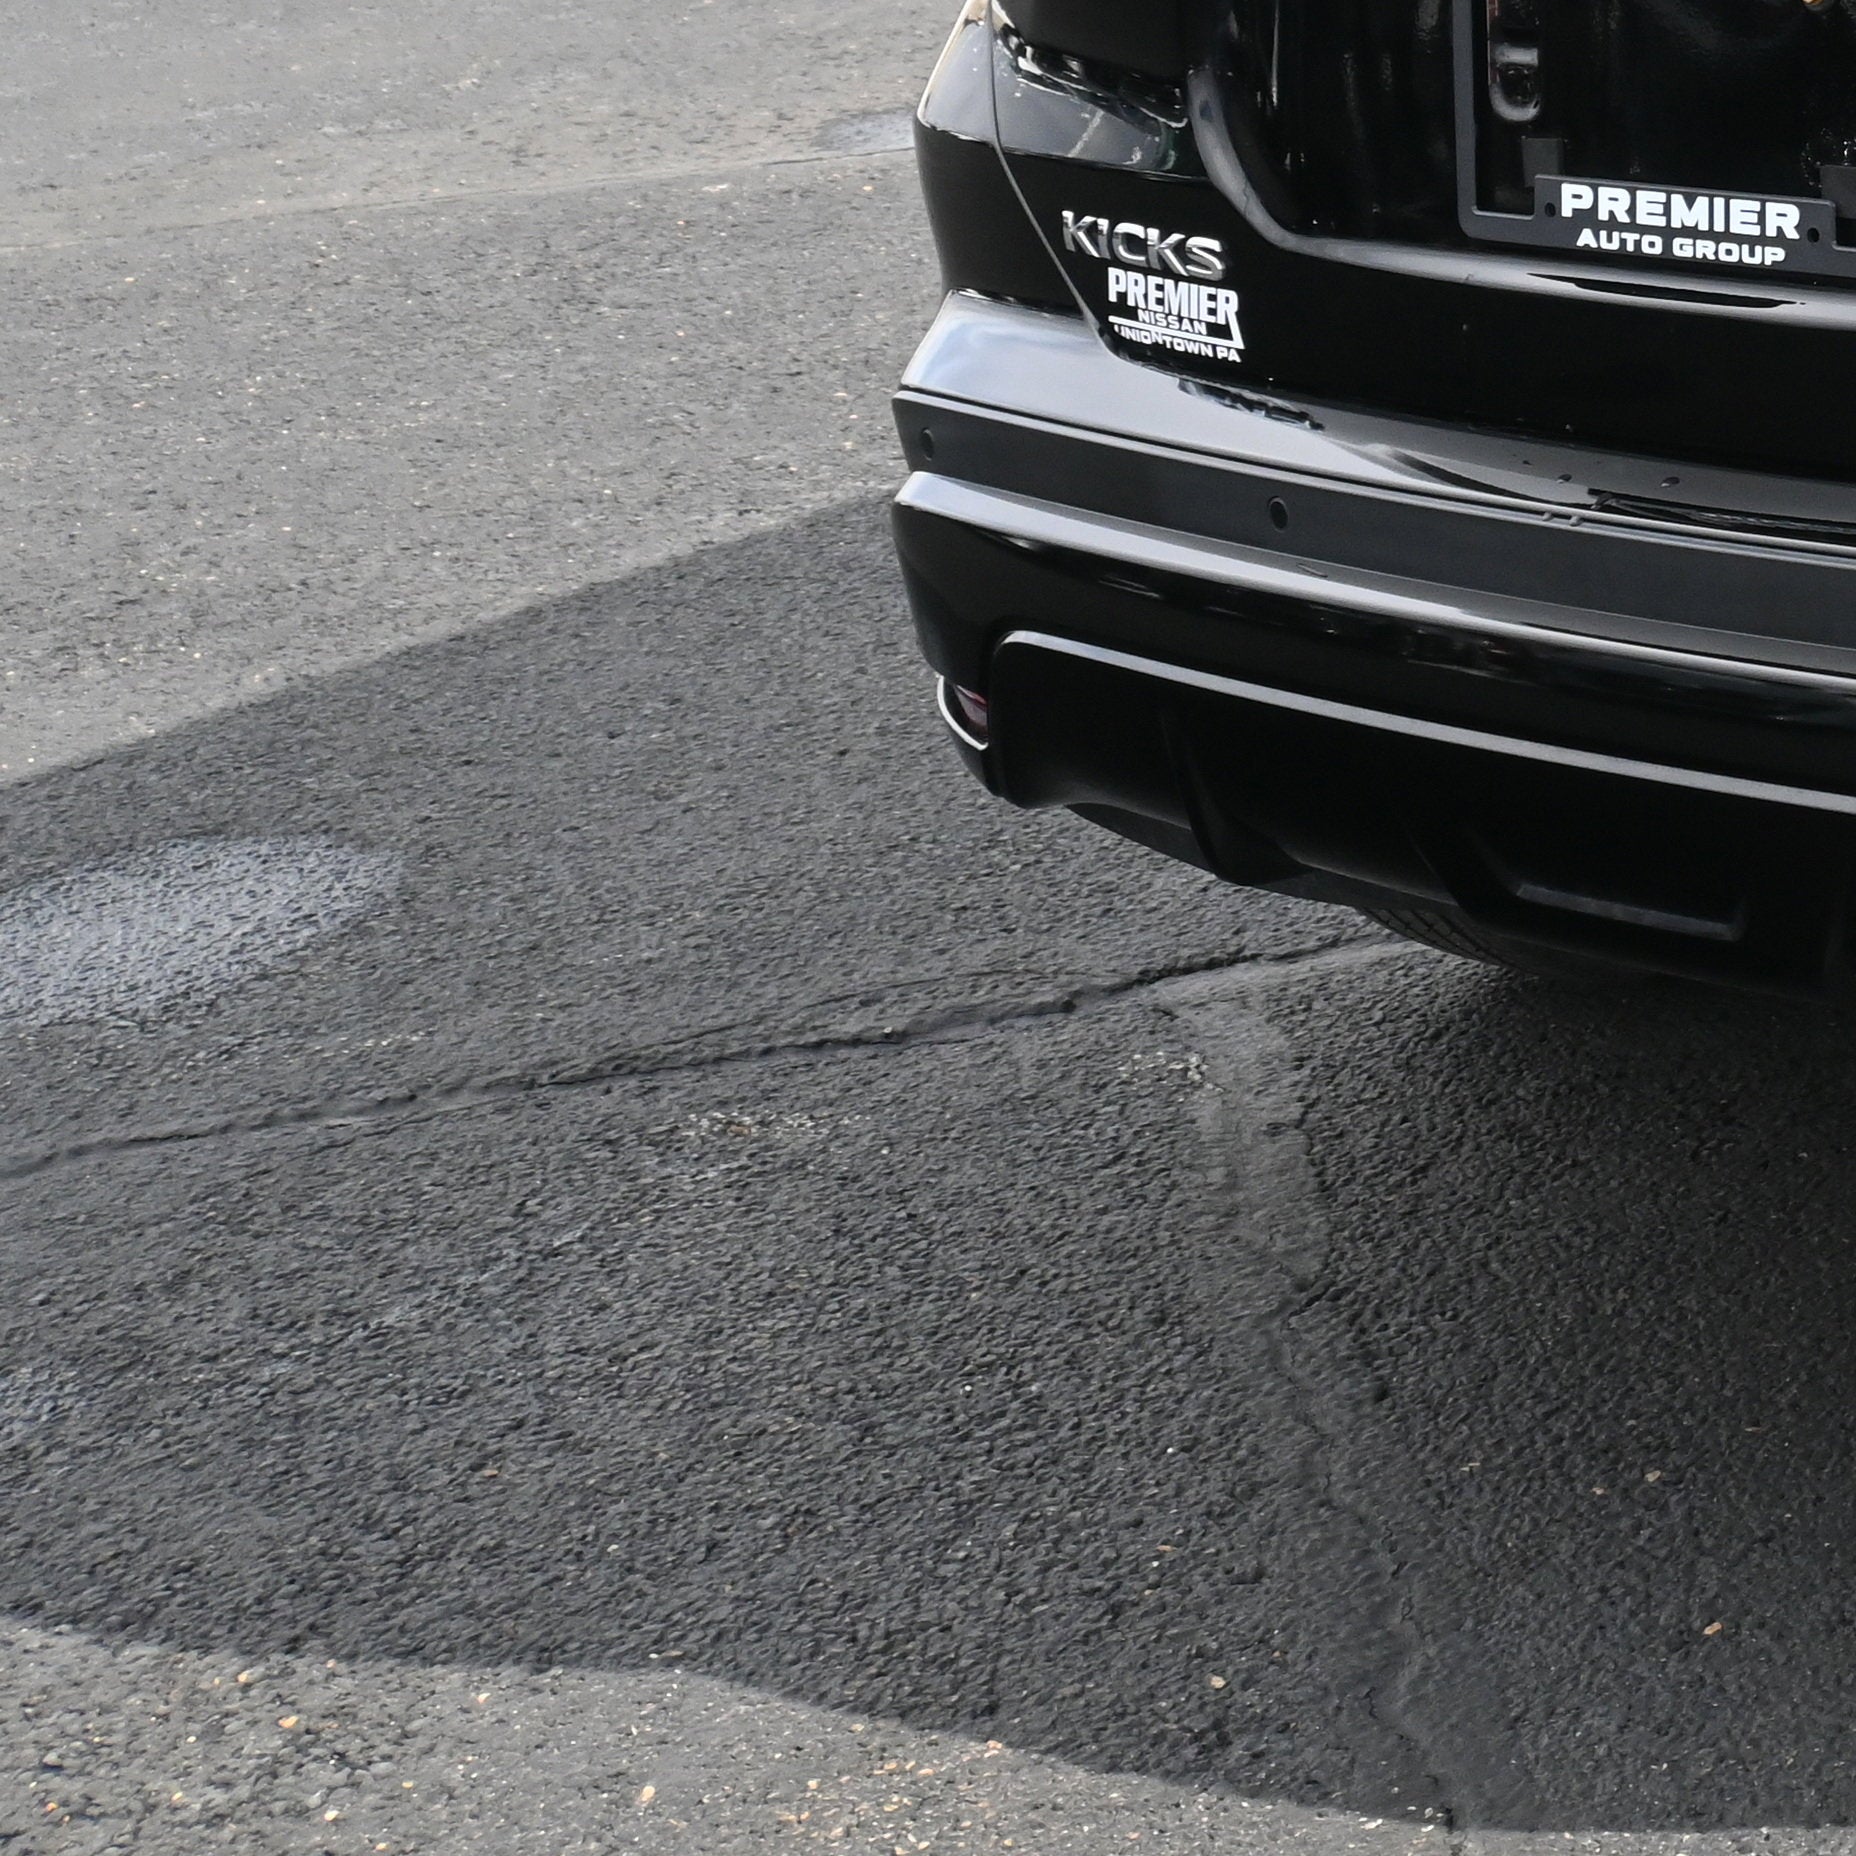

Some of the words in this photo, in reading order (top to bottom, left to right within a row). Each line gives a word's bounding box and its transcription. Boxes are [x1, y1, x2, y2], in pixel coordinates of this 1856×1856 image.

[1560, 182, 1801, 240] PREMIER
[1061, 210, 1227, 281] KICKS
[1576, 227, 1663, 256] AUTO
[1671, 237, 1786, 267] GROUP
[1107, 266, 1240, 327] PREMIER
[1137, 308, 1208, 336] NISSAN
[1216, 346, 1242, 363] PA
